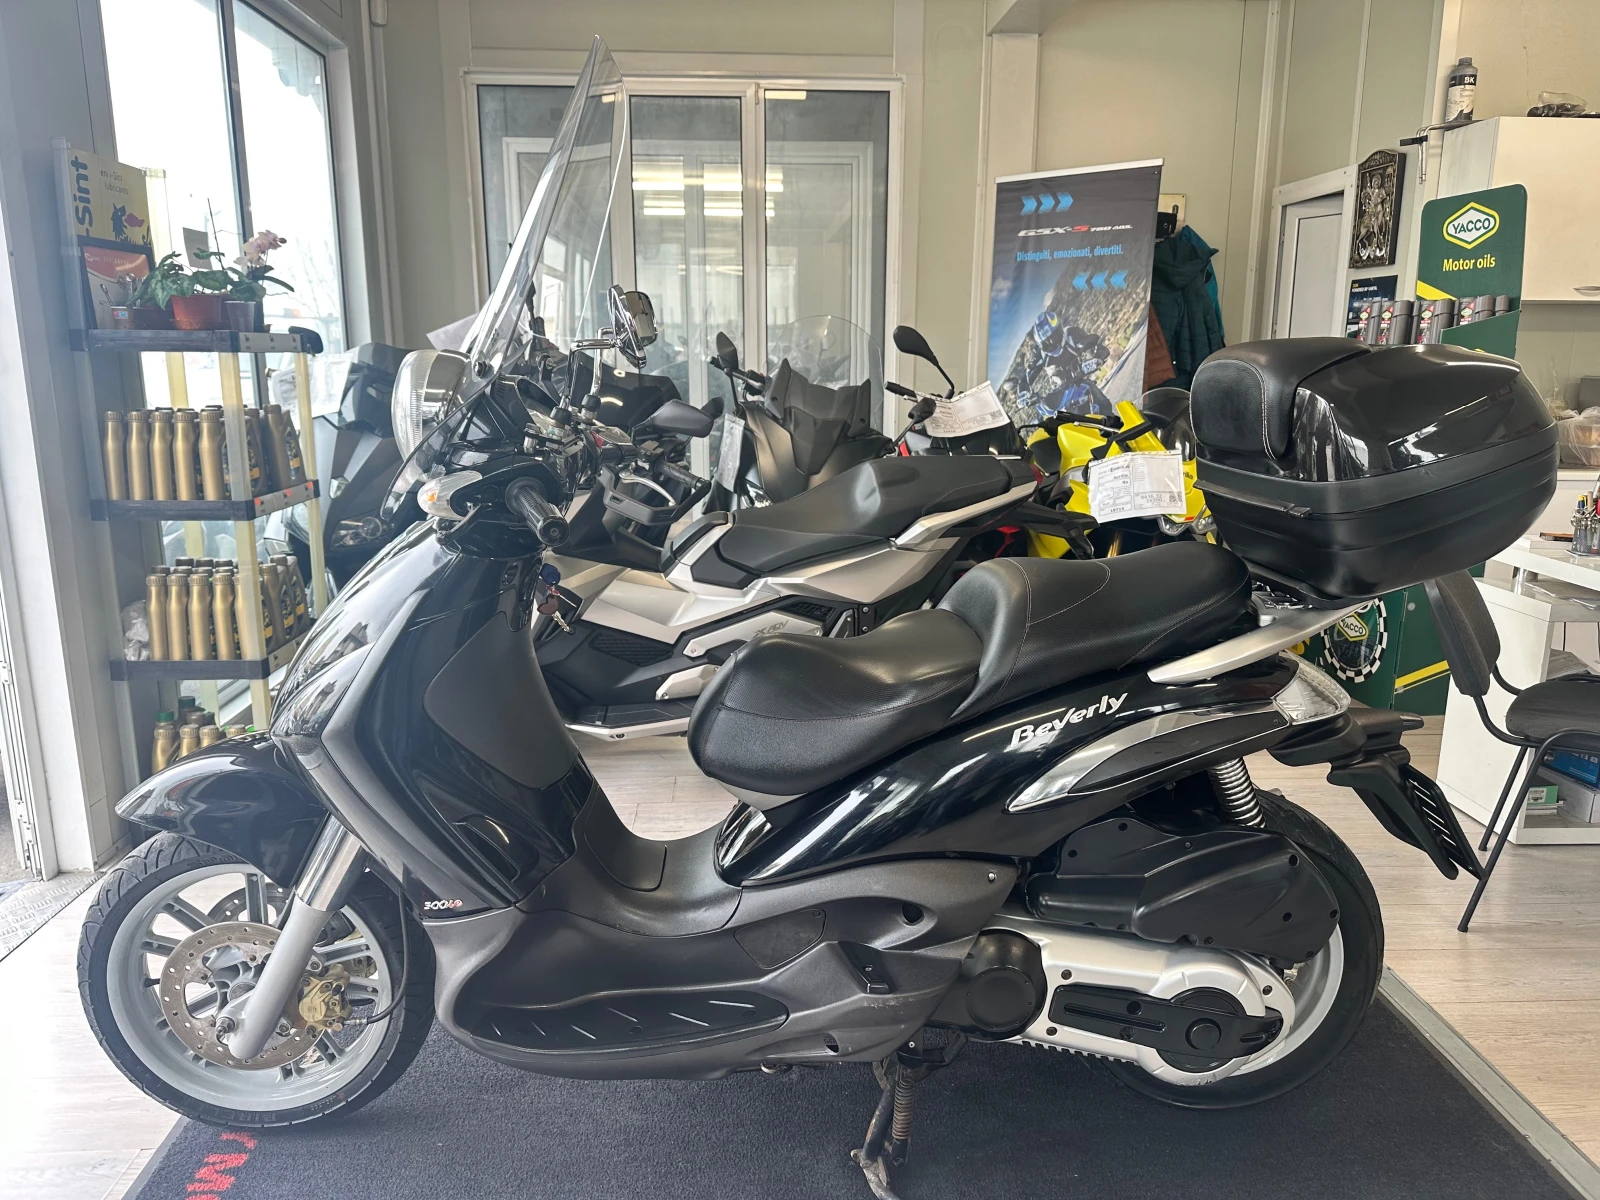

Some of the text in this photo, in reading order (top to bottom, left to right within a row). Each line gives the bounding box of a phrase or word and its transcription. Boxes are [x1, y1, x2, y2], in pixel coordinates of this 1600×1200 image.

[1464, 76, 1475, 84] BK
[71, 155, 94, 237] -Sint
[104, 181, 129, 195] lubricants
[1452, 217, 1491, 234] YACCO
[1016, 244, 1124, 262] Distinguiti, emozionati, divertiti.
[1442, 253, 1496, 272] Motor oils
[1341, 618, 1364, 635] YACCO
